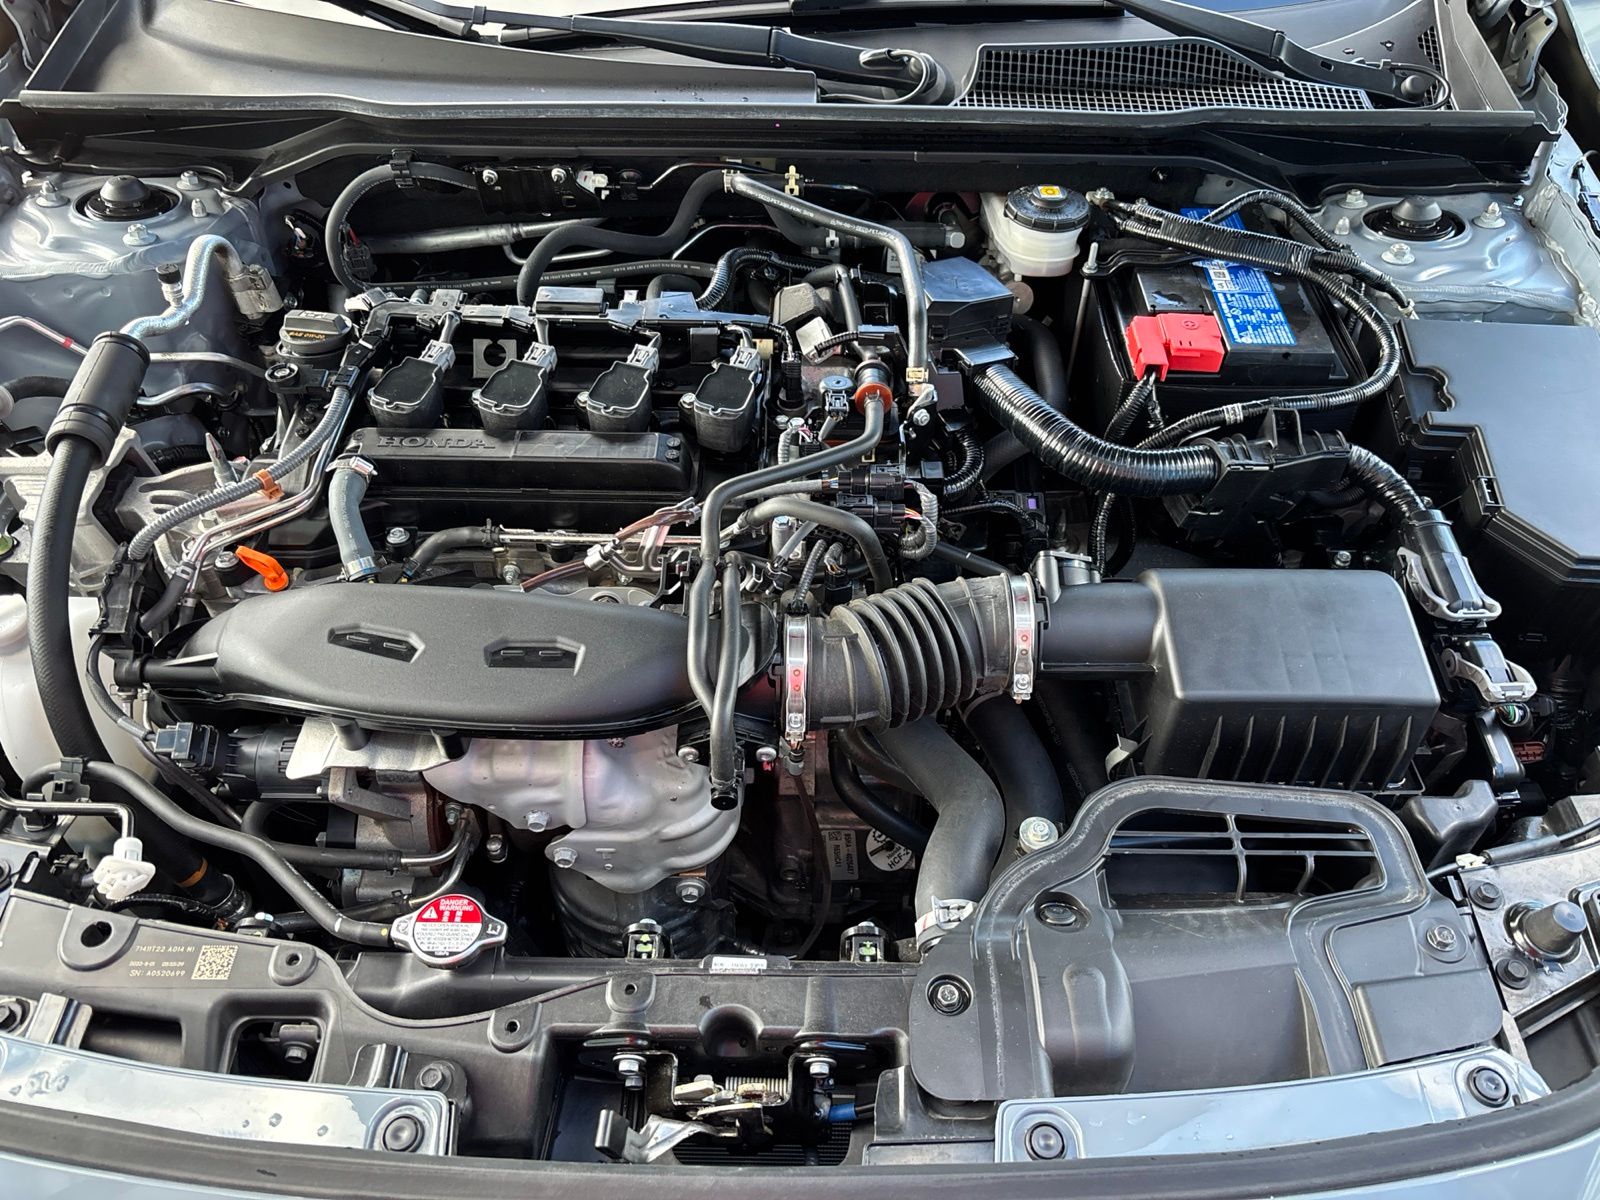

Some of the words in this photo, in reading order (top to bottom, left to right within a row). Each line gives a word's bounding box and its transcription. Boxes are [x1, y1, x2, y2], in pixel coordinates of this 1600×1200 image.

[377, 436, 496, 449] HONDA
[887, 848, 911, 869] HCF-2
[146, 969, 186, 977] A0520699
